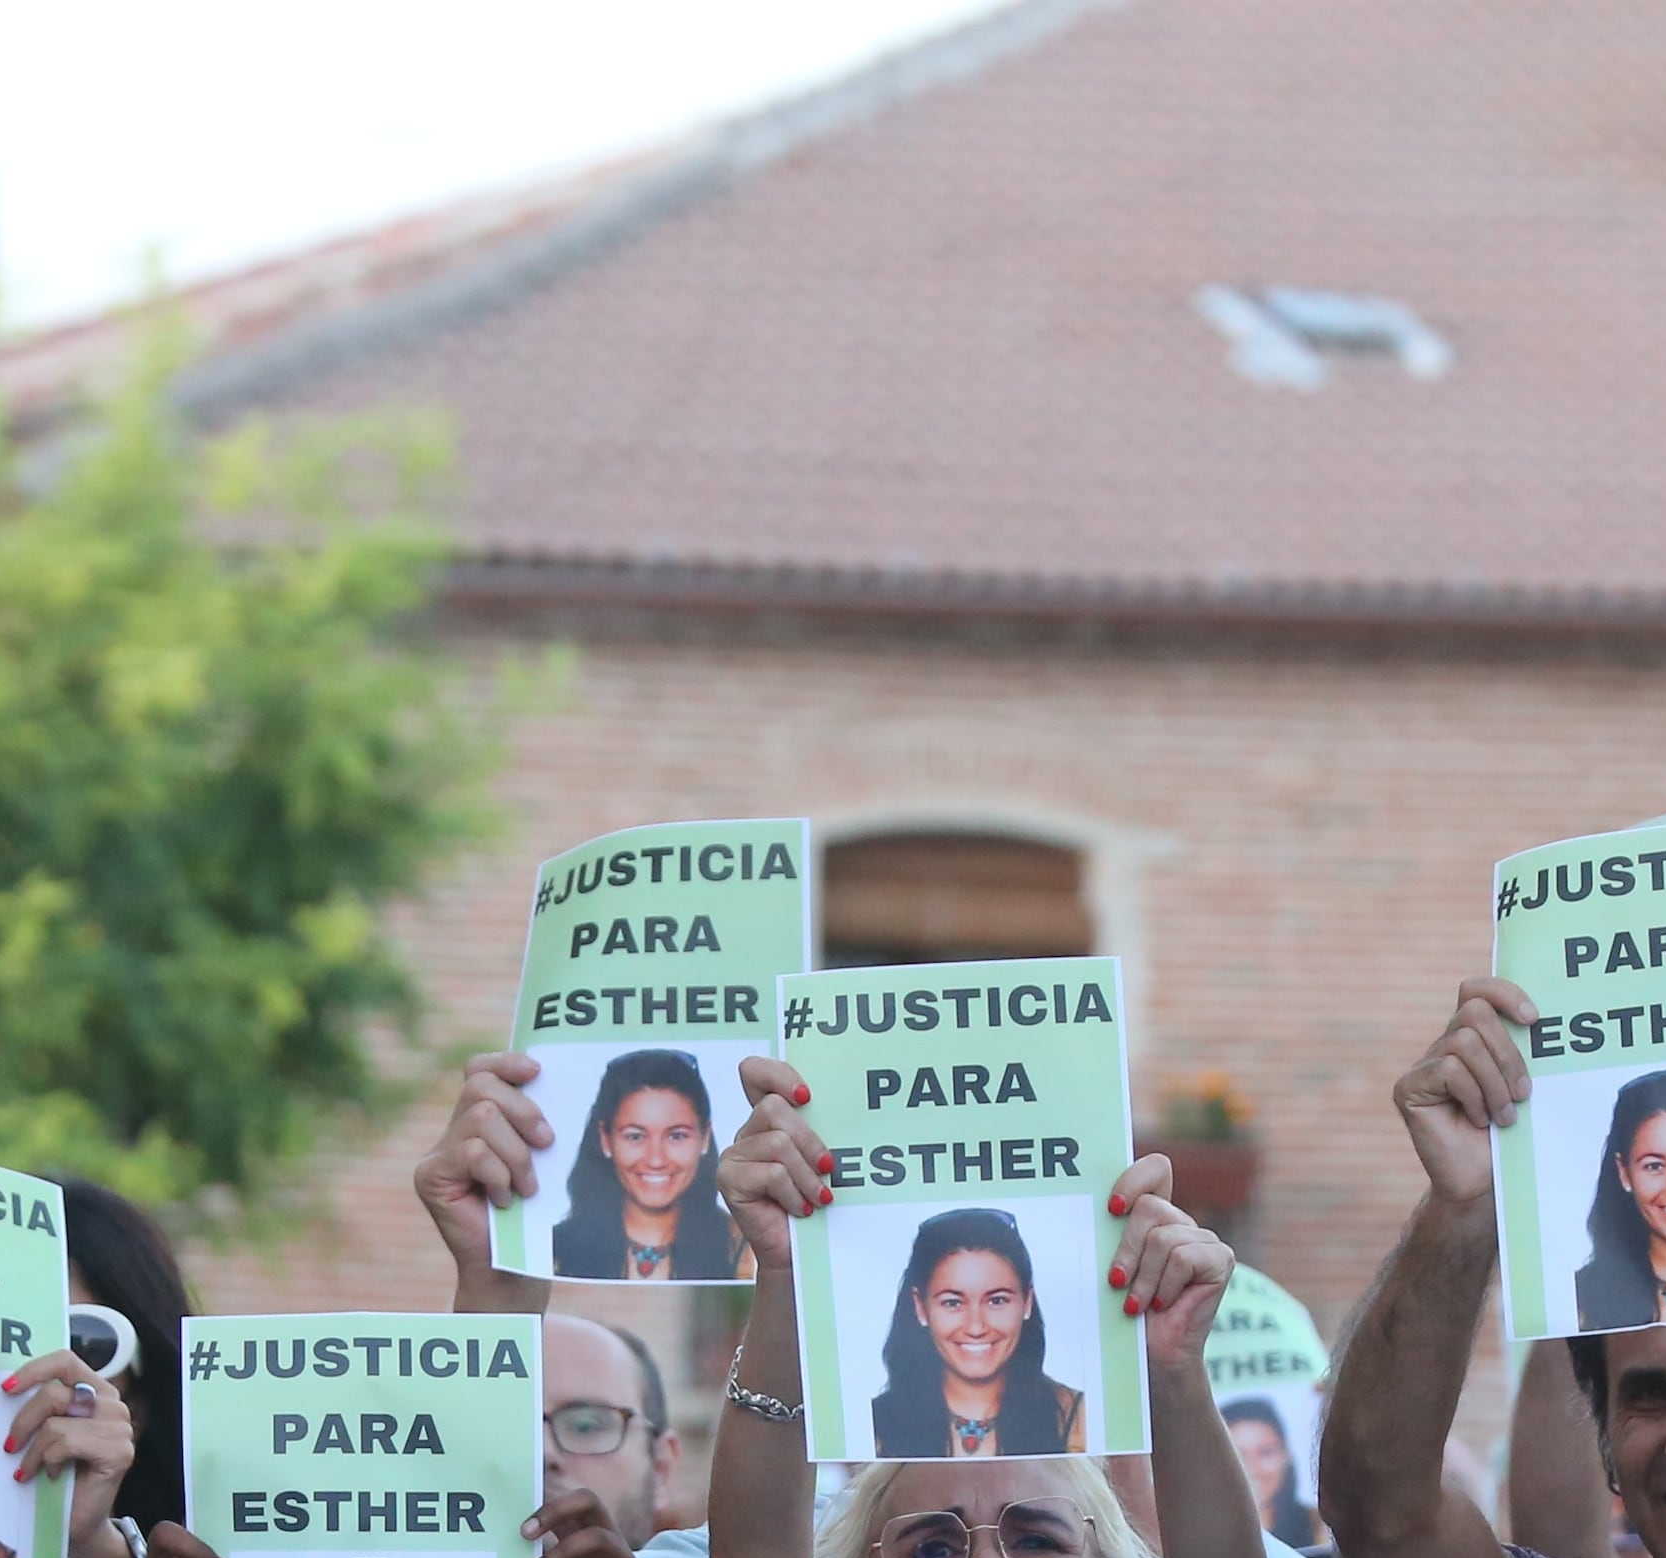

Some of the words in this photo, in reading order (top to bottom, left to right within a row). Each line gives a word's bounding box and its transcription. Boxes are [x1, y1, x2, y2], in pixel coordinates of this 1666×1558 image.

[535, 843, 797, 917] #JUSTICIA
[570, 915, 721, 958] PARA
[533, 985, 759, 1030] ESTHER
[784, 982, 1113, 1039] #JUSTICIA
[866, 1062, 1037, 1110] PARA
[829, 1137, 1081, 1188] ESTHER
[189, 1337, 529, 1380] #JUSTICIA
[273, 1413, 446, 1455] PARA
[233, 1491, 486, 1533] ESTHER
